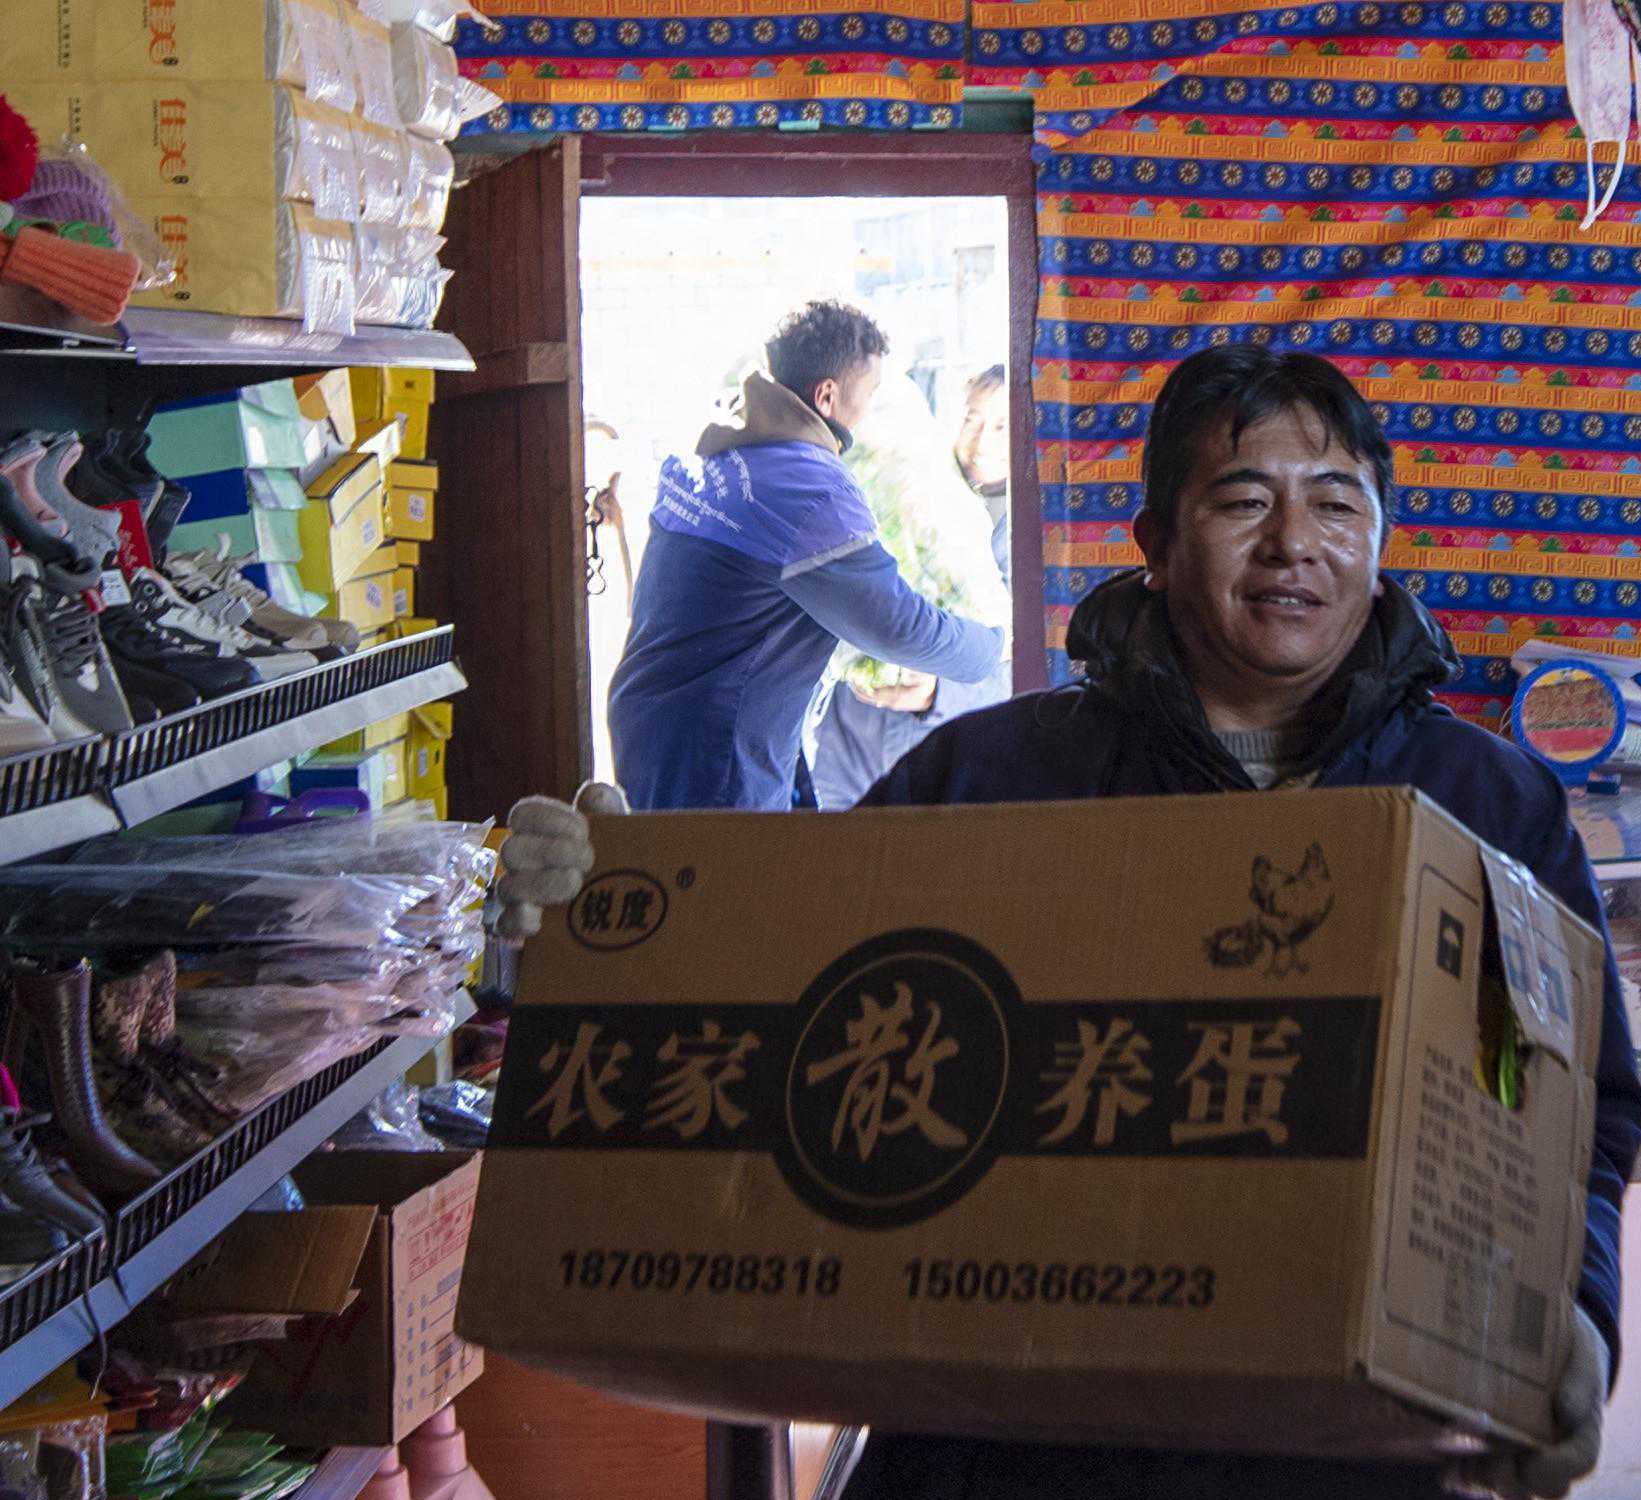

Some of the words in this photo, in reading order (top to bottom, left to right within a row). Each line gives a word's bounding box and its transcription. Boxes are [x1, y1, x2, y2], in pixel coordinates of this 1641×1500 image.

[581, 889, 655, 933] 锐度
[560, 1250, 843, 1295] 18709788318
[904, 1256, 1217, 1308] 15003662223
